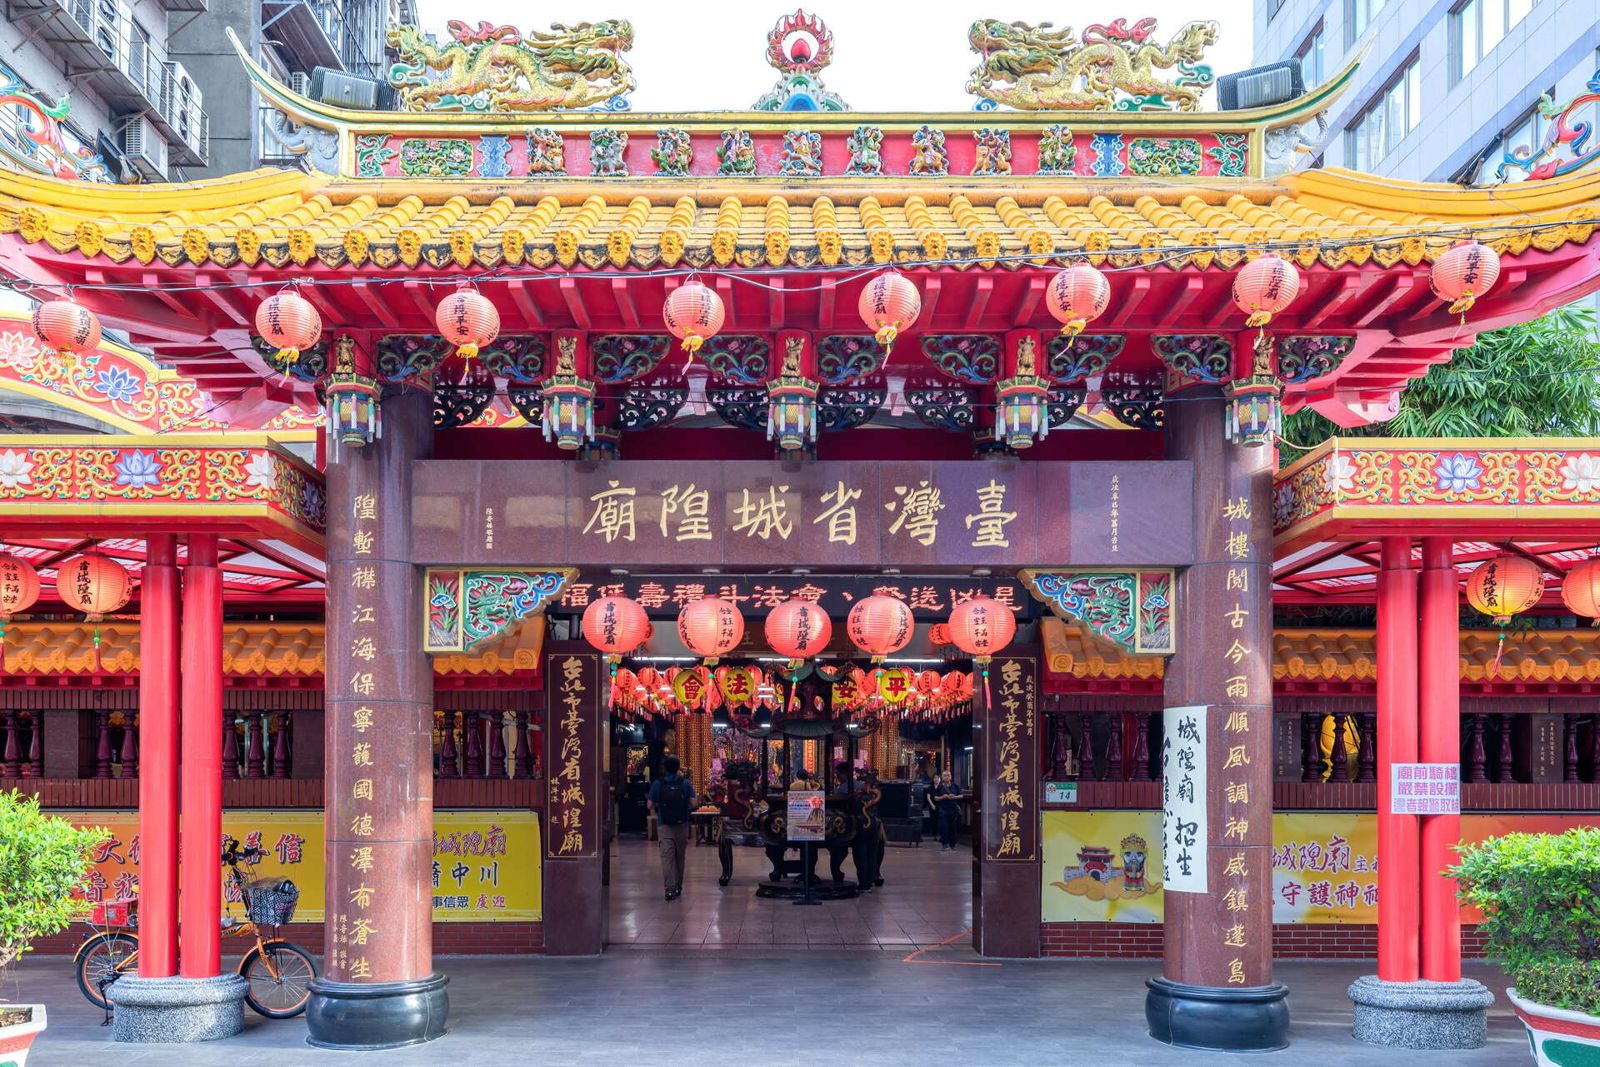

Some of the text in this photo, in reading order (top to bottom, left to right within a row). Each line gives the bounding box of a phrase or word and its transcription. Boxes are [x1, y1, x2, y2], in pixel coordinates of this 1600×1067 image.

[582, 481, 1017, 548] 臺灣省城隍廟
[681, 674, 704, 700] 會
[726, 673, 749, 695] 法
[886, 676, 907, 698] 平
[1059, 791, 1071, 800] 14
[1175, 715, 1200, 876] 城隍廟 招生
